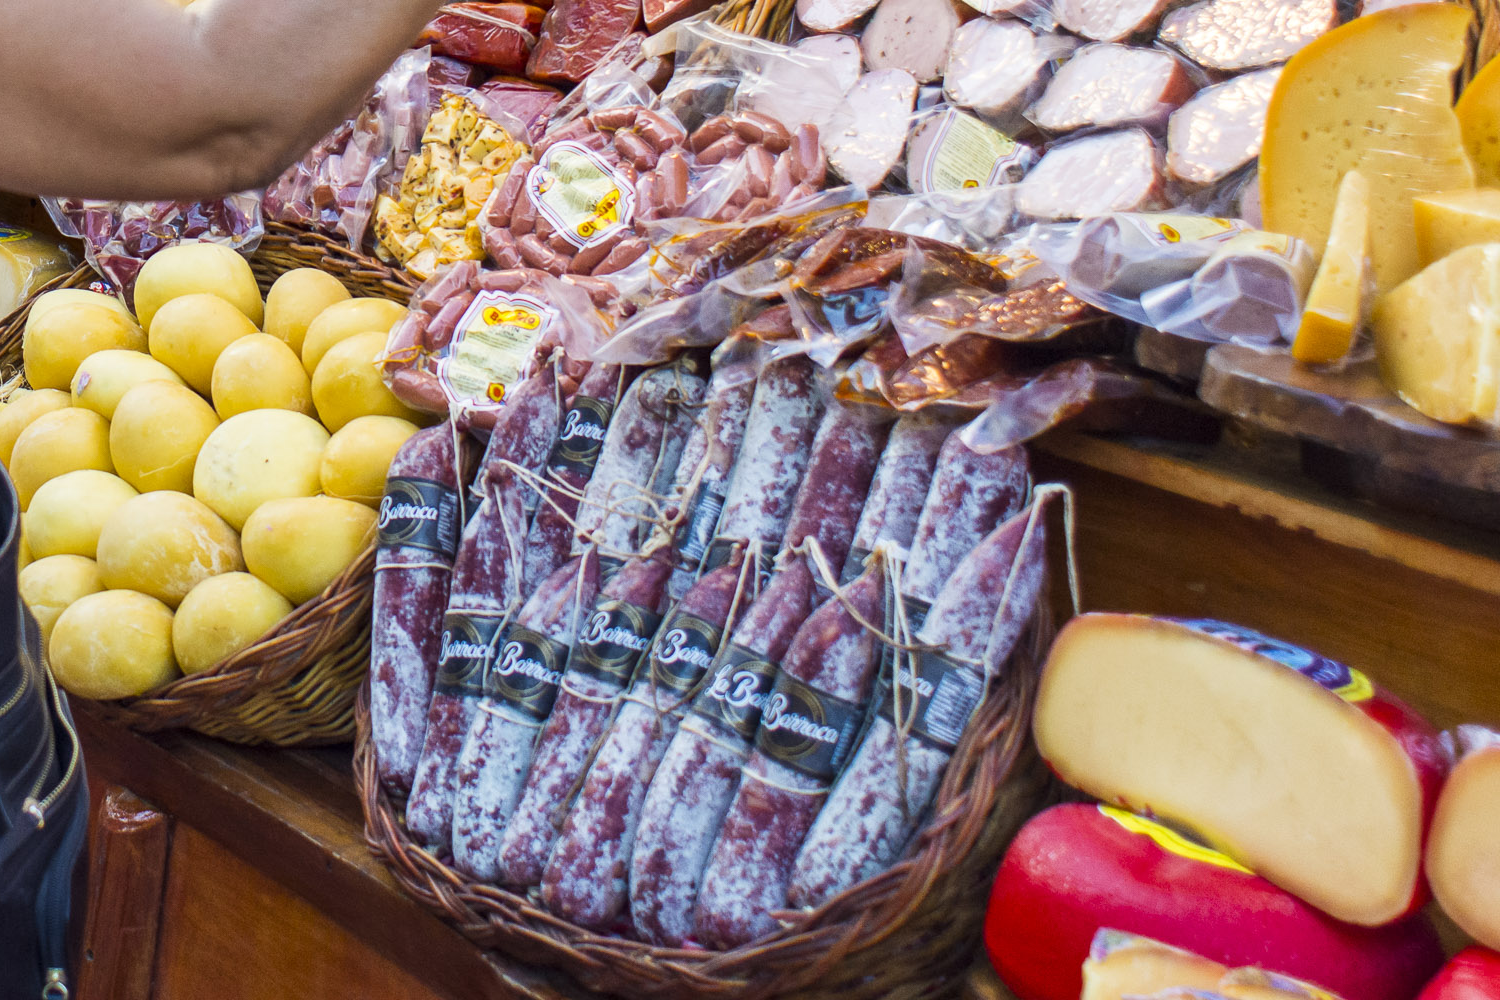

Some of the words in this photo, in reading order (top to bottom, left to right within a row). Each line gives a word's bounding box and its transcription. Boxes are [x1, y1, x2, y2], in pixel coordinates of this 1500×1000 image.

[560, 409, 605, 441] Barra
[378, 495, 439, 529] Barraca
[764, 692, 838, 744] Barraca
